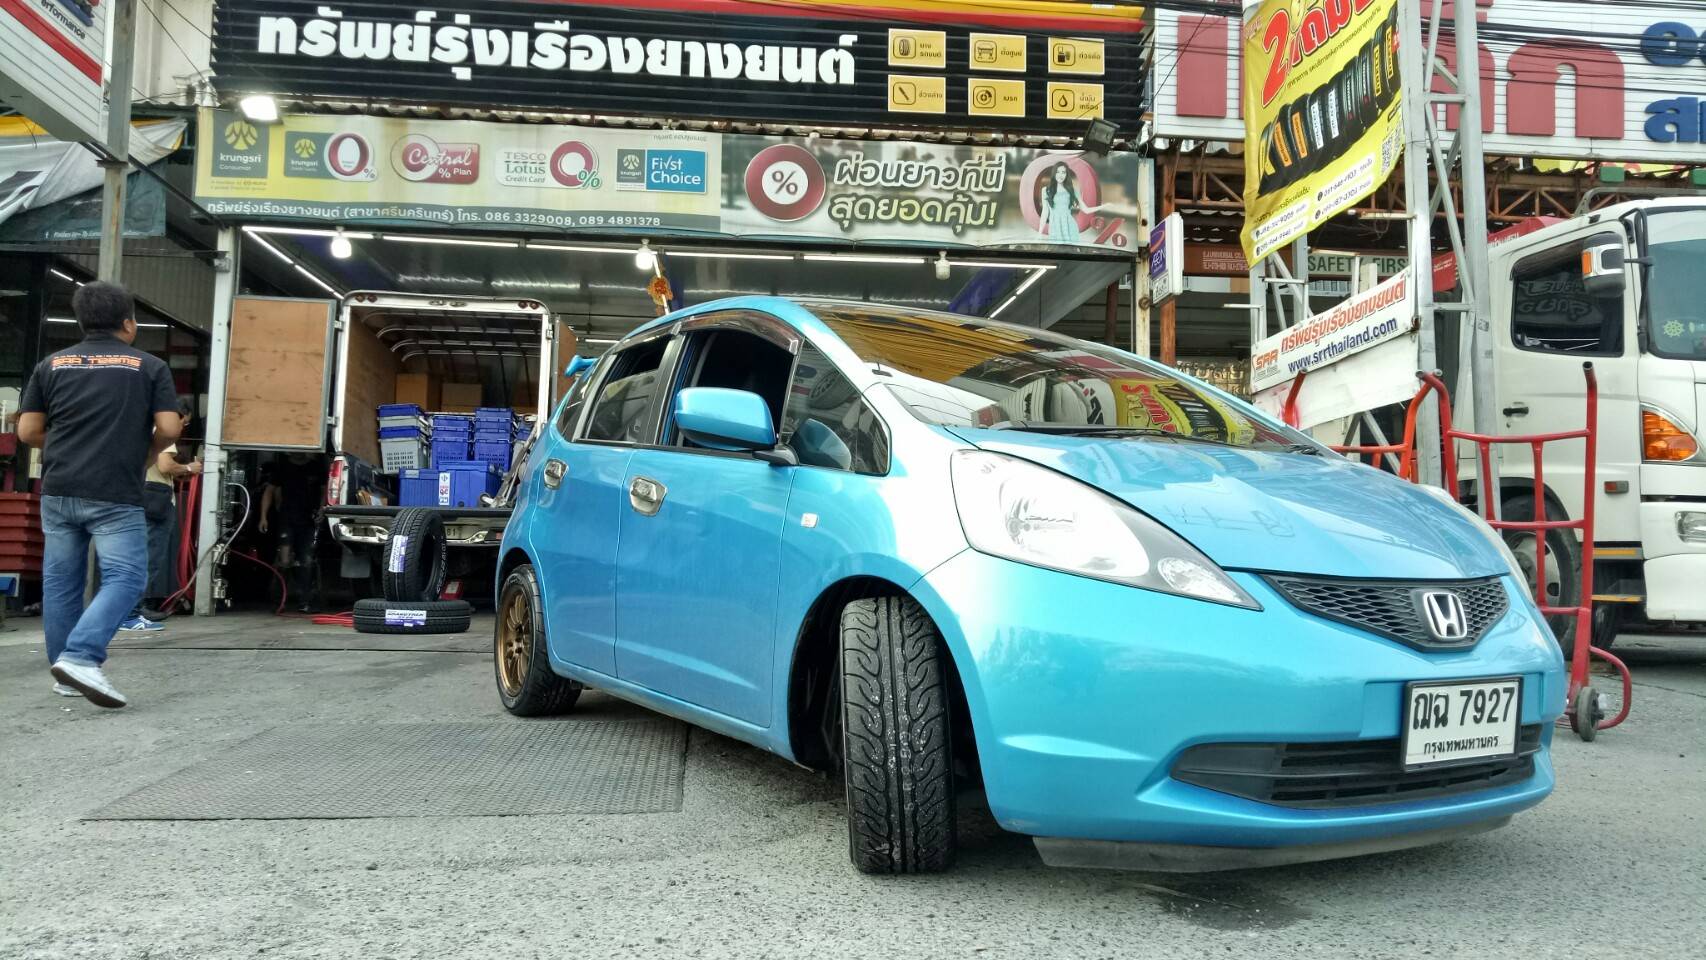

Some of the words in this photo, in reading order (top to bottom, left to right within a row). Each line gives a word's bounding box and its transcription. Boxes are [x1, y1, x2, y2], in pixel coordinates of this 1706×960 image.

[258, 6, 858, 85] ทรัพย์รุ่งเรืองยางยนต์
[220, 153, 262, 164] krungsri
[290, 159, 318, 167] krungsri
[408, 147, 473, 166] Central
[504, 152, 547, 160] TESCO
[453, 167, 472, 176] Plan
[505, 163, 546, 175] Lotus
[651, 171, 701, 185] Choice
[834, 151, 1006, 192] ผ่อนยาวที่นี่
[207, 201, 341, 218] ทรัพย์รุ่งเรืองยางยนต์
[457, 208, 481, 221] โทร.
[485, 211, 510, 221] 086
[515, 212, 576, 226] 3329008,
[579, 215, 604, 225] 089
[608, 215, 661, 226] 4891378
[829, 193, 998, 234] สุดยอดคุ้ม!
[1281, 272, 1407, 353] ทรัพย์รุ่งเรืองยางยนต์
[1288, 316, 1397, 374] www.srrthailand.com
[1459, 687, 1516, 726] 7927
[1424, 735, 1499, 759] กรุงเทพมหานคร
